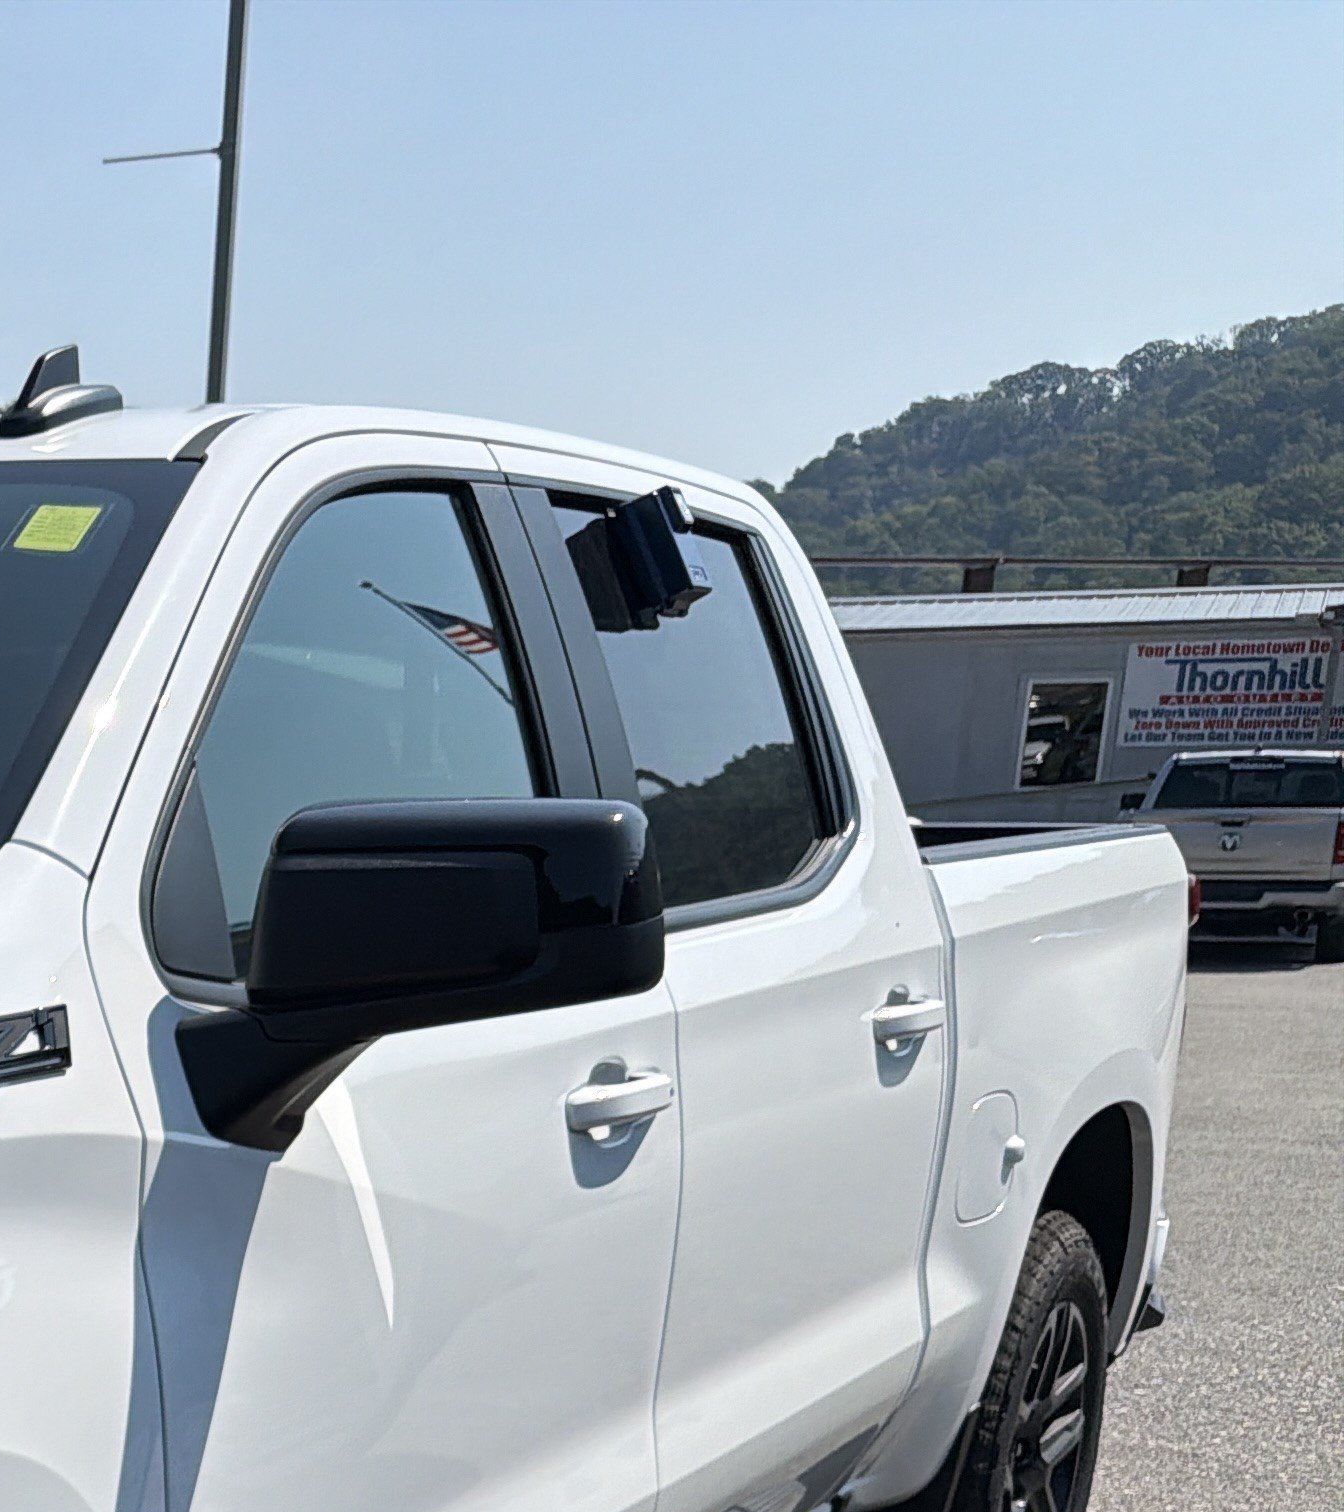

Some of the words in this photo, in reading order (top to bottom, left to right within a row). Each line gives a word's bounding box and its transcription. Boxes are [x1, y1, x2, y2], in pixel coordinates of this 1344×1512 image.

[1137, 644, 1172, 658] Your
[1174, 643, 1216, 657] Local
[1219, 640, 1306, 656] Hometown
[1165, 656, 1325, 693] Thornhill
[1128, 707, 1149, 719] We
[1152, 707, 1185, 718] Work
[1188, 706, 1218, 718] With
[1221, 706, 1238, 717] All
[1241, 705, 1283, 717] Credit
[1134, 720, 1162, 731] Zero
[1165, 719, 1201, 730] Down
[1203, 718, 1234, 730] With
[1236, 717, 1300, 730] Approved
[1124, 731, 1143, 743] Let
[1145, 731, 1168, 742] Our
[1171, 730, 1205, 742] Team
[1207, 730, 1229, 742] Get
[1233, 730, 1256, 742] You
[1258, 730, 1272, 741] In
[1273, 730, 1284, 741] A
[1285, 729, 1315, 741] New
